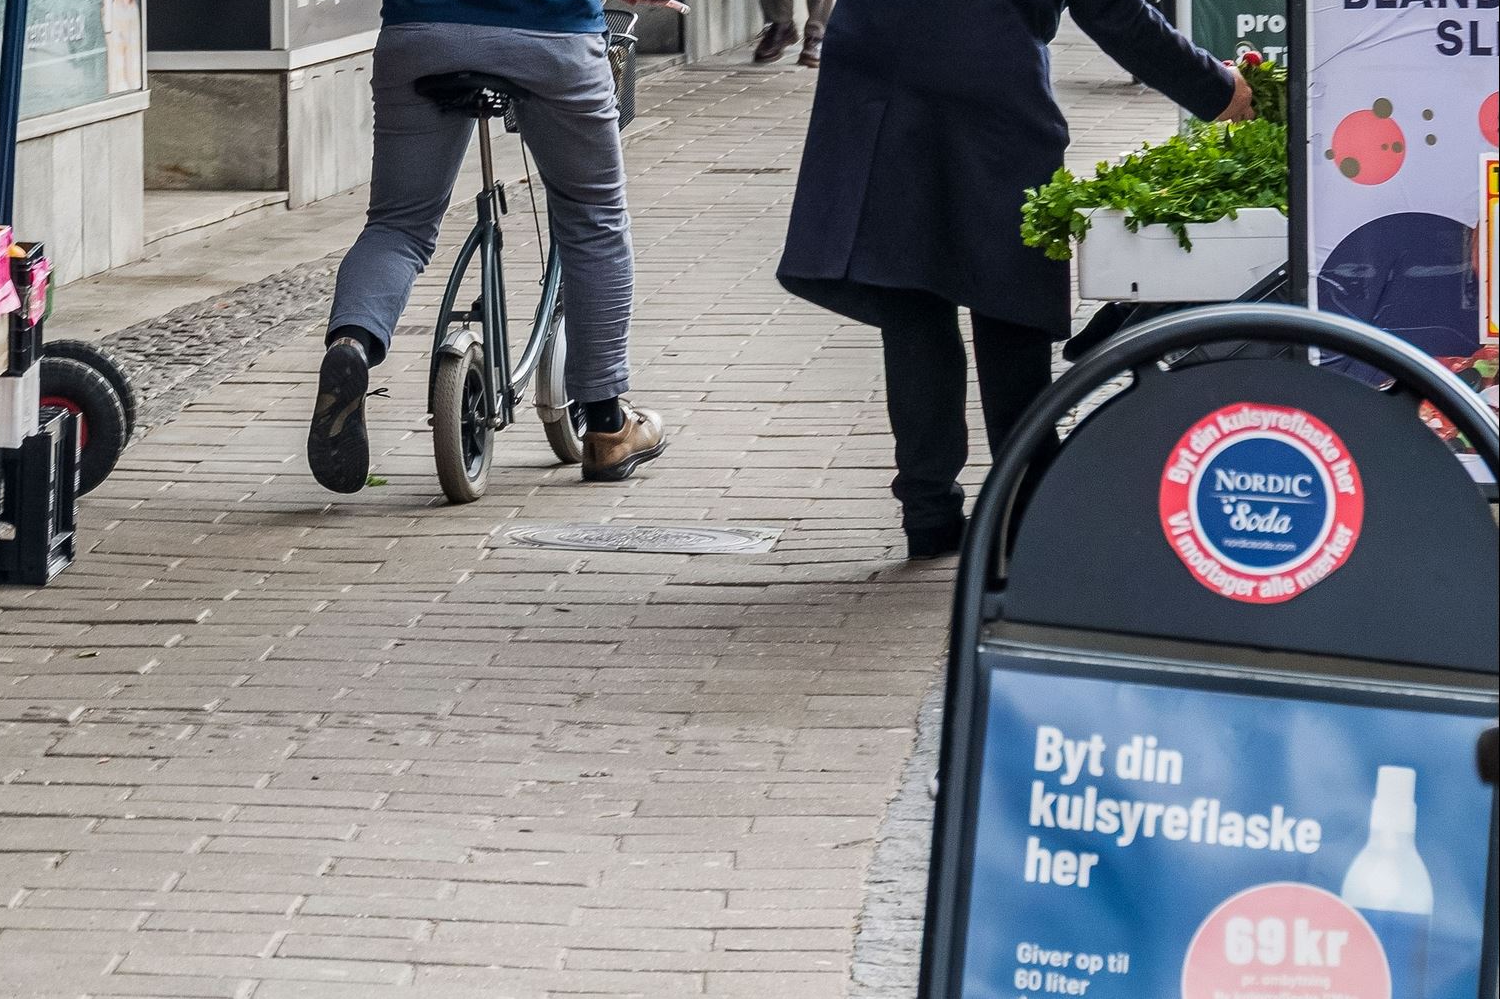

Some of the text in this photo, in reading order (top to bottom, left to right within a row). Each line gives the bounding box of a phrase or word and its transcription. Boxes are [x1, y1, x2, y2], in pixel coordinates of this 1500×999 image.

[1237, 13, 1287, 38] pro
[1168, 406, 1356, 495] Byt din kulsyreflaske her
[1214, 467, 1313, 498] NORDIC
[1229, 502, 1293, 534] Soda
[1168, 509, 1354, 599] Vi modtager alle mærker
[1033, 725, 1184, 786] Byt din
[1028, 779, 1322, 855] kulsyreflaske
[1023, 835, 1100, 888] her
[1016, 942, 1130, 975] Giver op til
[1224, 916, 1349, 968] 69 kr
[1014, 968, 1091, 996] 60 liter
